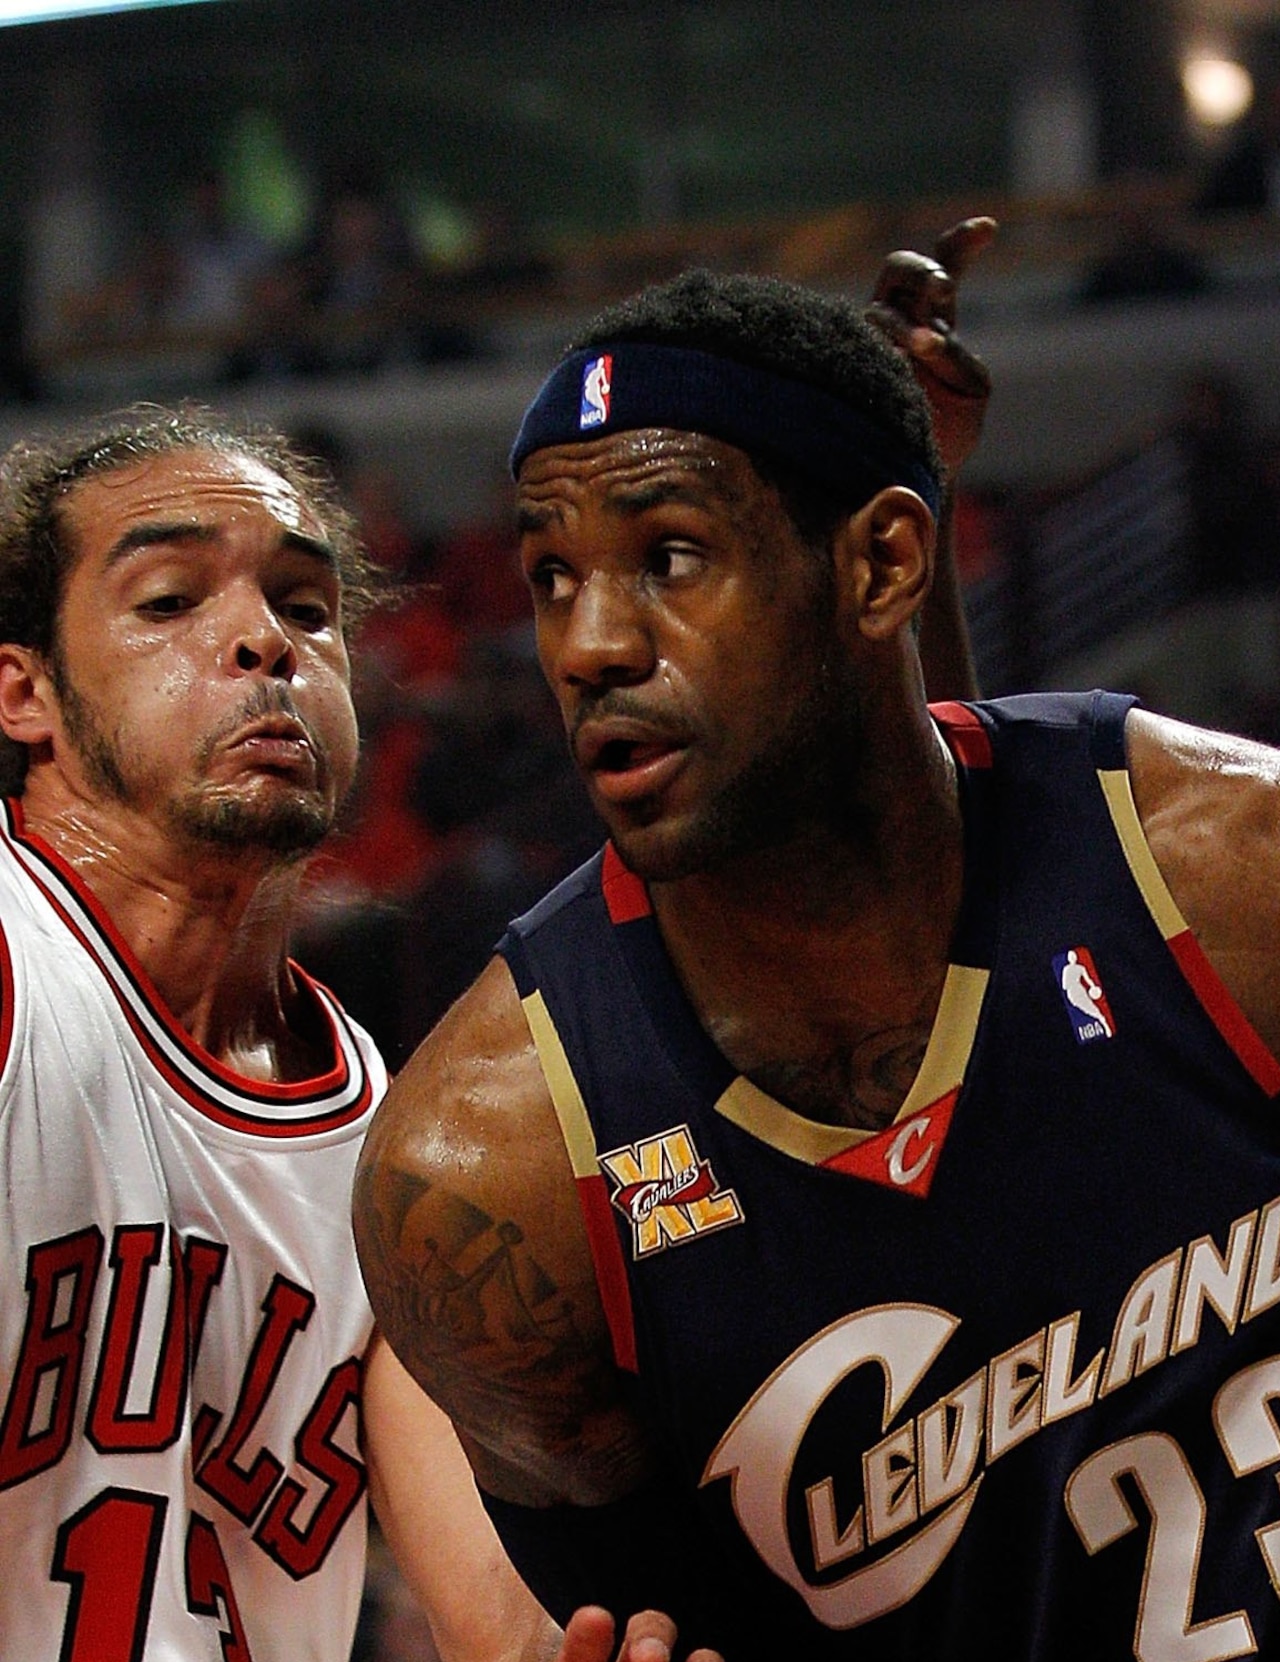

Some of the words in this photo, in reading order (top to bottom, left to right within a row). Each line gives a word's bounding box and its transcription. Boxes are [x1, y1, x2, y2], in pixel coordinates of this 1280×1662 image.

[1078, 1021, 1104, 1041] NBA
[630, 1162, 699, 1223] CAVALIERS
[0, 1223, 368, 1581] BULLS
